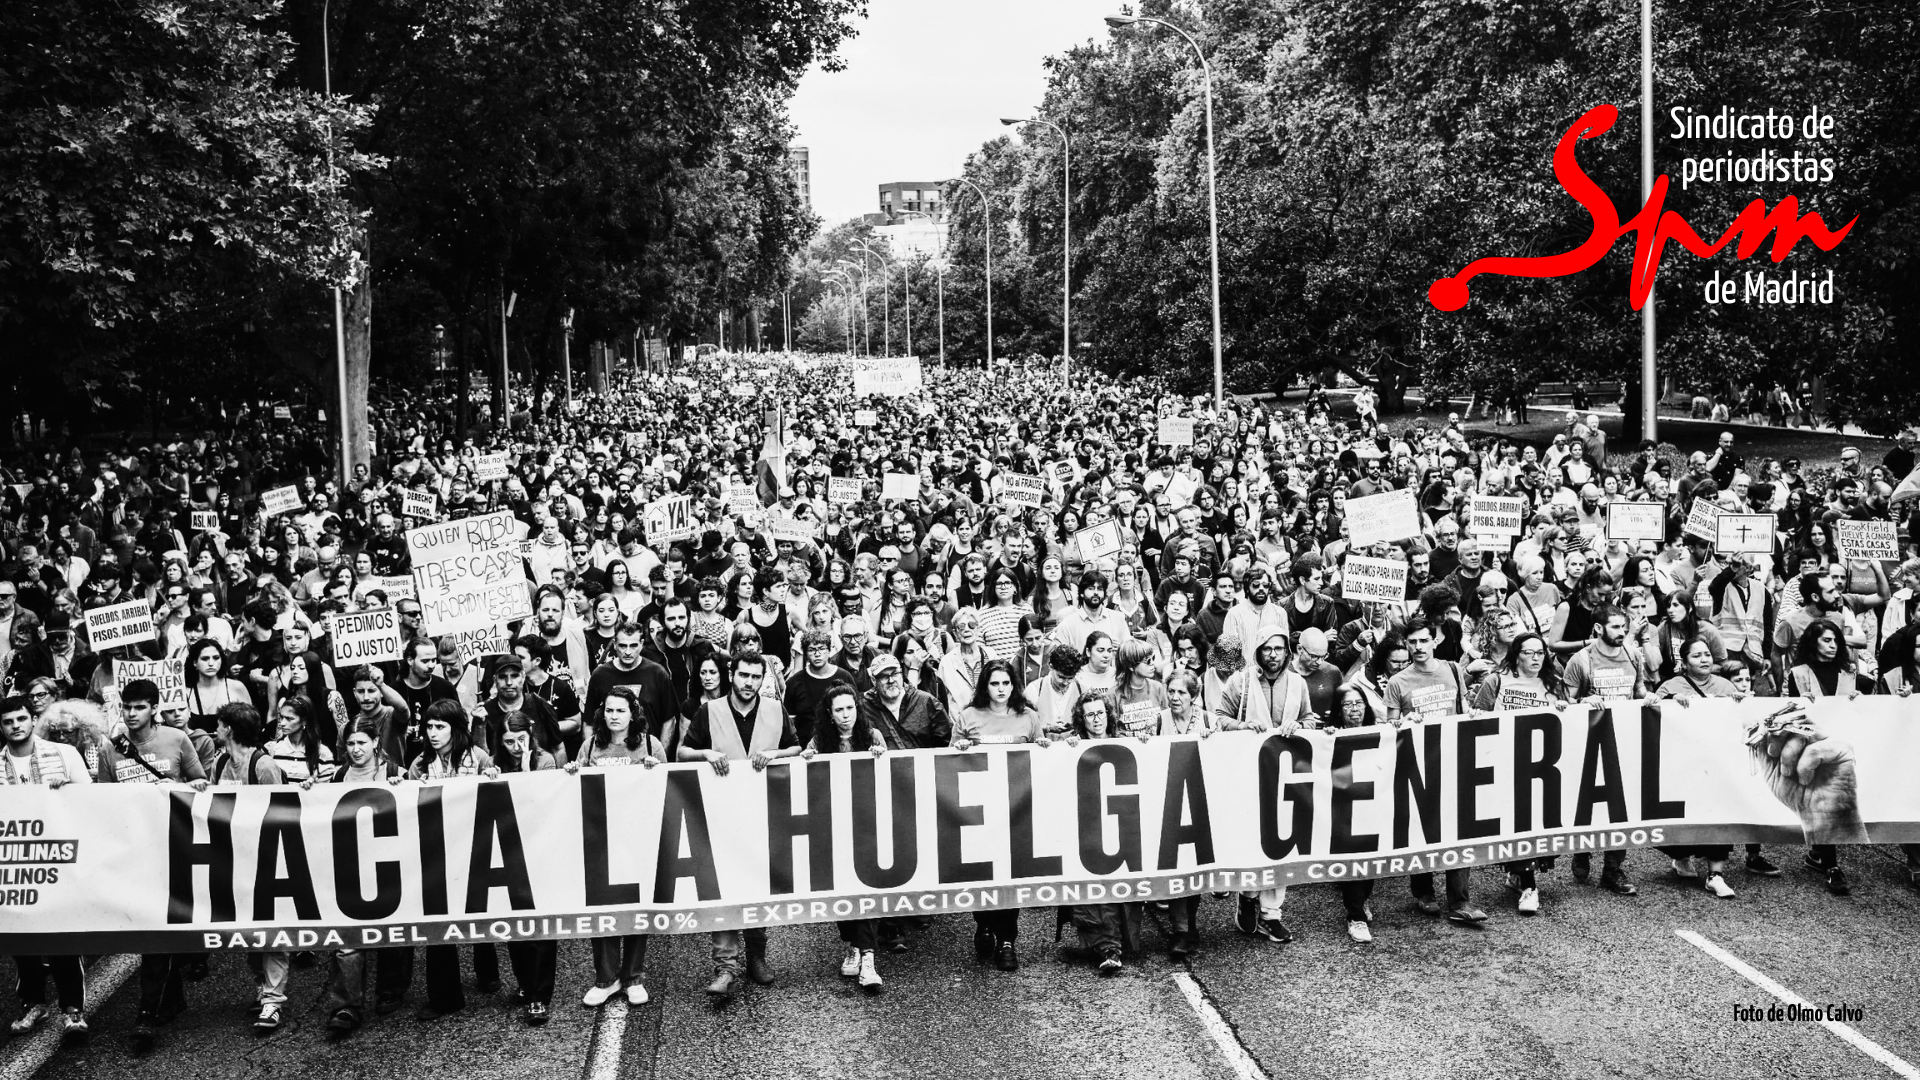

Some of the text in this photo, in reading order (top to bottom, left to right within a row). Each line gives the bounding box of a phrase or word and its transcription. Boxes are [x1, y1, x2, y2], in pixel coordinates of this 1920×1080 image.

[1005, 475, 1014, 487] NO
[1021, 478, 1042, 490] FRAUDE
[407, 492, 433, 504] DERECHO
[407, 504, 411, 513] A
[668, 499, 689, 530] YA!
[206, 514, 217, 528] NO
[1474, 516, 1519, 528] PISOS, ABAJO!
[1840, 520, 1889, 532] Brookfield
[413, 526, 460, 549] QUIEN
[1841, 539, 1891, 549] ESTAS CASAS
[1844, 548, 1899, 559] SON NUESTRAS
[414, 556, 467, 590] TRES
[470, 548, 521, 577] CASAS
[1348, 562, 1376, 579] OCUPAMOS
[1376, 566, 1391, 580] PARA
[1364, 582, 1378, 596] PARA
[89, 604, 149, 627] SUELDOS, ARRIBA!
[489, 602, 531, 620] SOLO
[92, 620, 152, 643] PISOS, ABAJO!
[334, 612, 393, 640] ¡PEDIMOS
[455, 628, 487, 644] UNO
[335, 636, 398, 660] LO JUSTO!
[117, 660, 183, 677] AQUI NO
[1504, 689, 1537, 698] SINDICATO
[167, 705, 1686, 924] HACIA LA HUELGA GENERAL
[203, 928, 345, 949] BAJADA
[362, 925, 428, 945] DEL
[443, 914, 617, 941] ALQUILER
[634, 912, 698, 930] 50%
[742, 884, 998, 925] EXPROPIACIÓN
[1017, 880, 1153, 904] FONDOS
[1169, 868, 1275, 895] BUITRE
[1307, 847, 1475, 880] CONTRATOS
[1487, 827, 1665, 864] INDEFINIDOS
